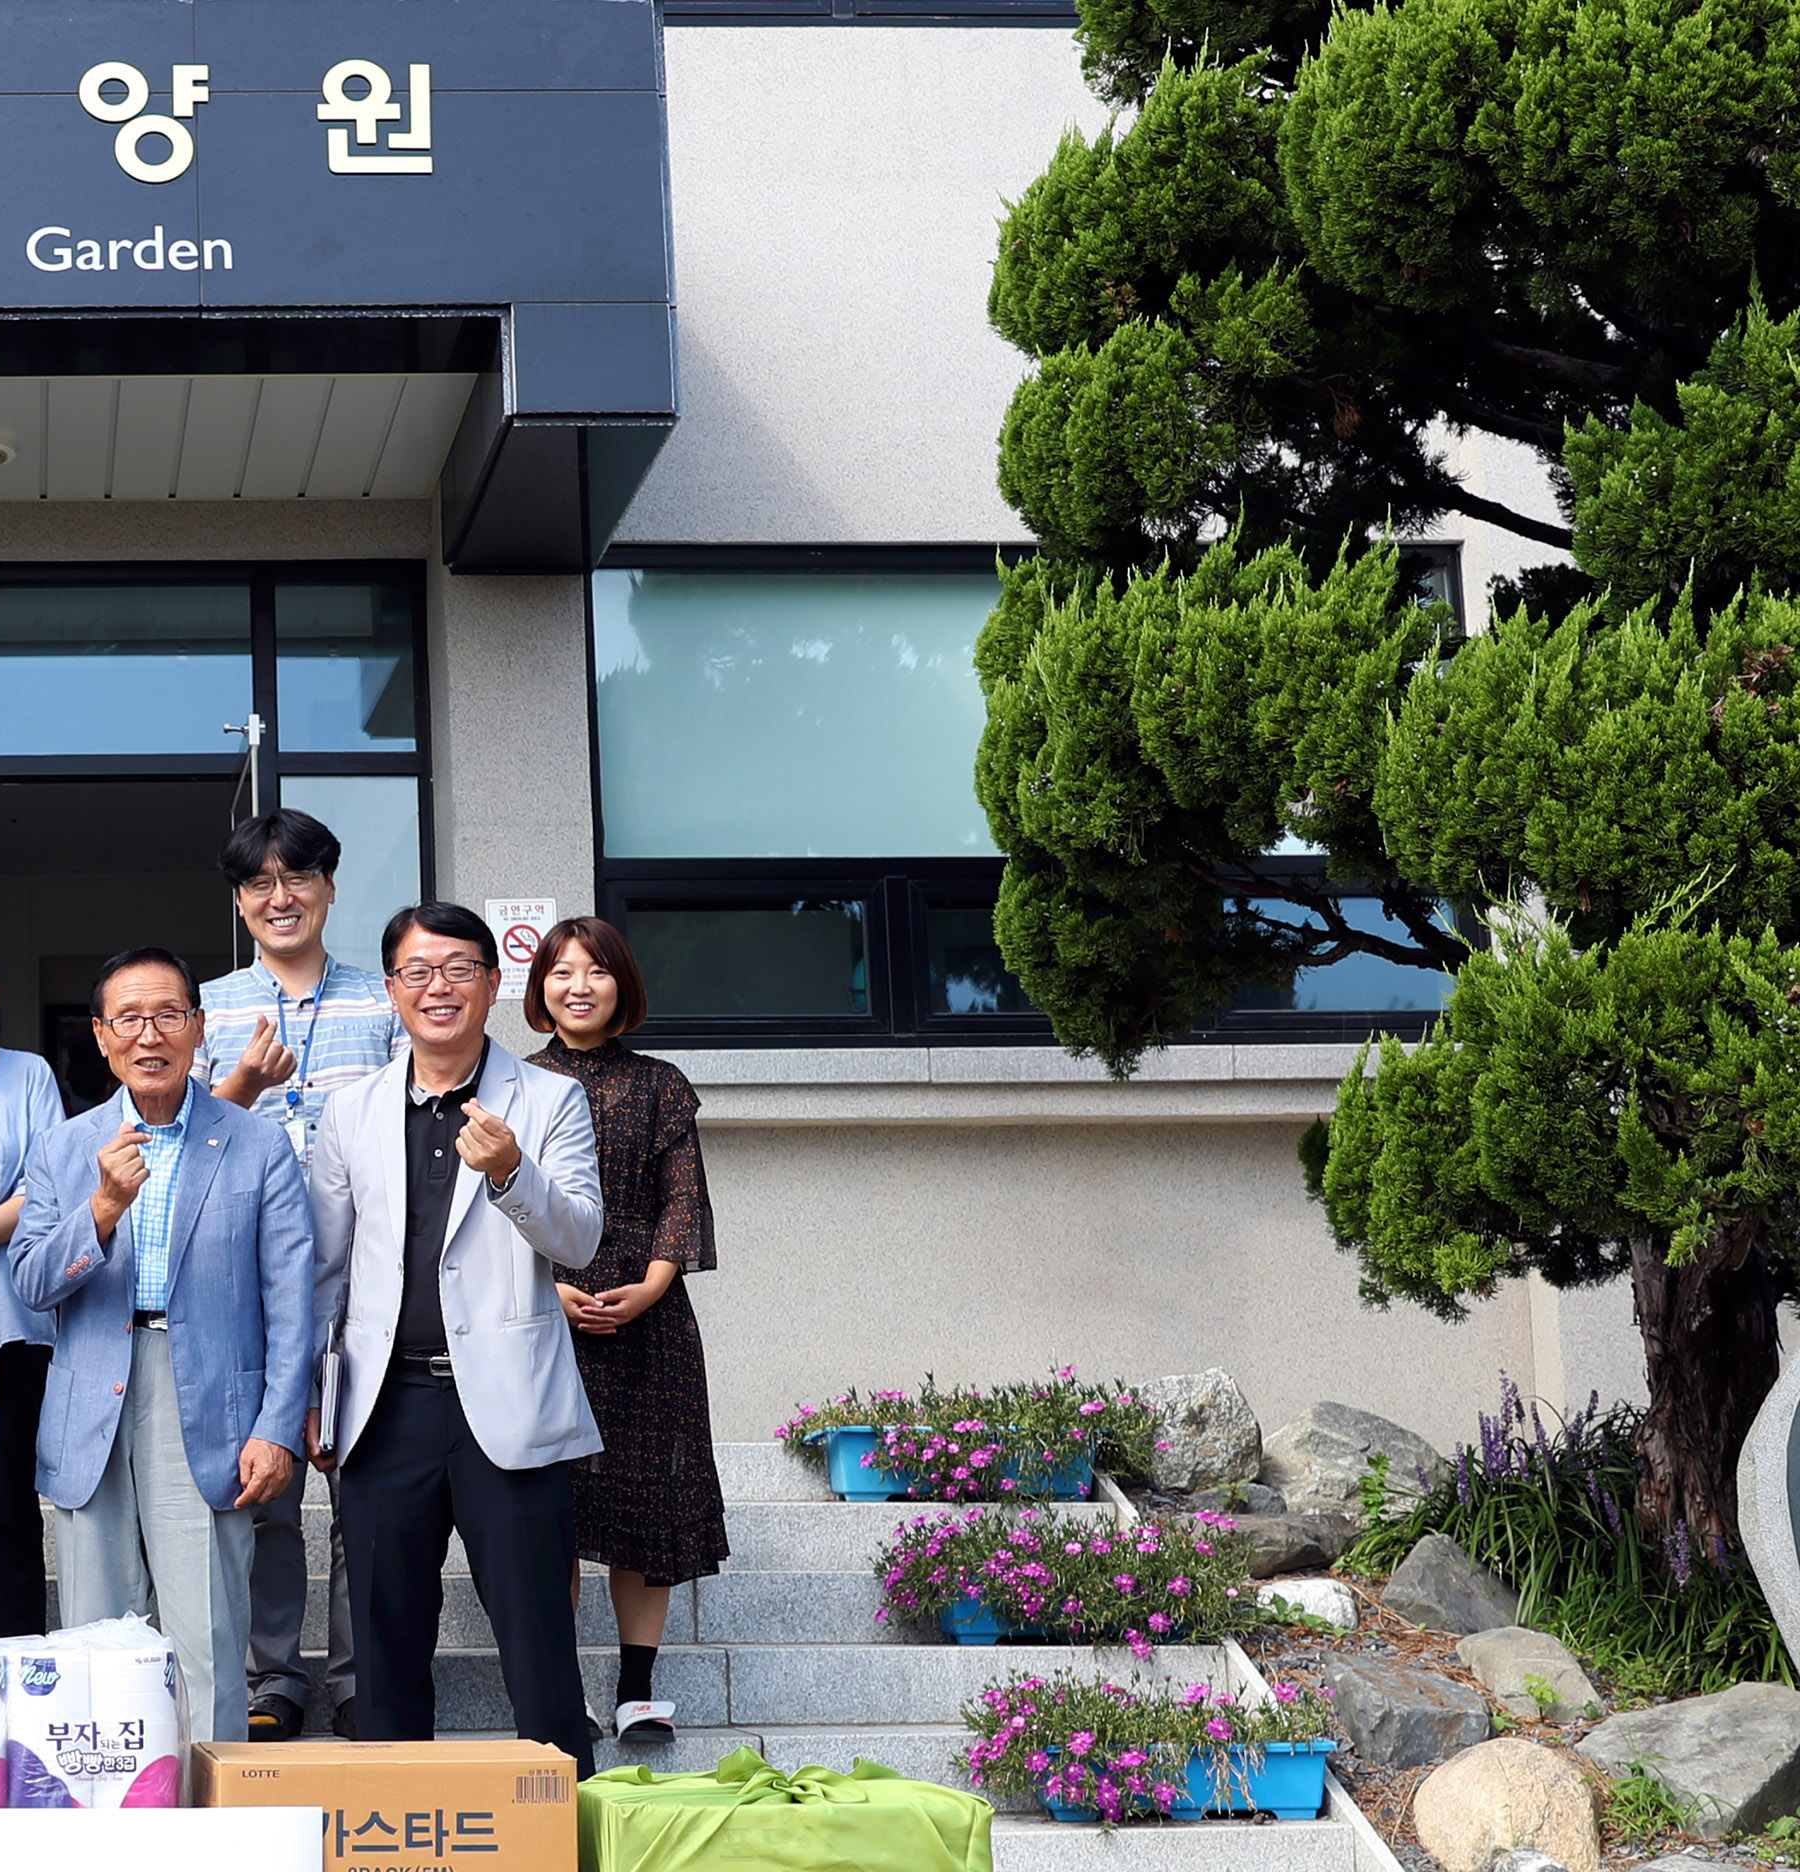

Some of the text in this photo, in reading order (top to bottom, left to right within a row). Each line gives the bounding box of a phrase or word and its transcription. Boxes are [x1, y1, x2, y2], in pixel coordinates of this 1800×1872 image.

[26, 225, 234, 273] Garden
[499, 905, 545, 916] 금연구역
[19, 1665, 61, 1685] New
[242, 1769, 280, 1779] LOTTE
